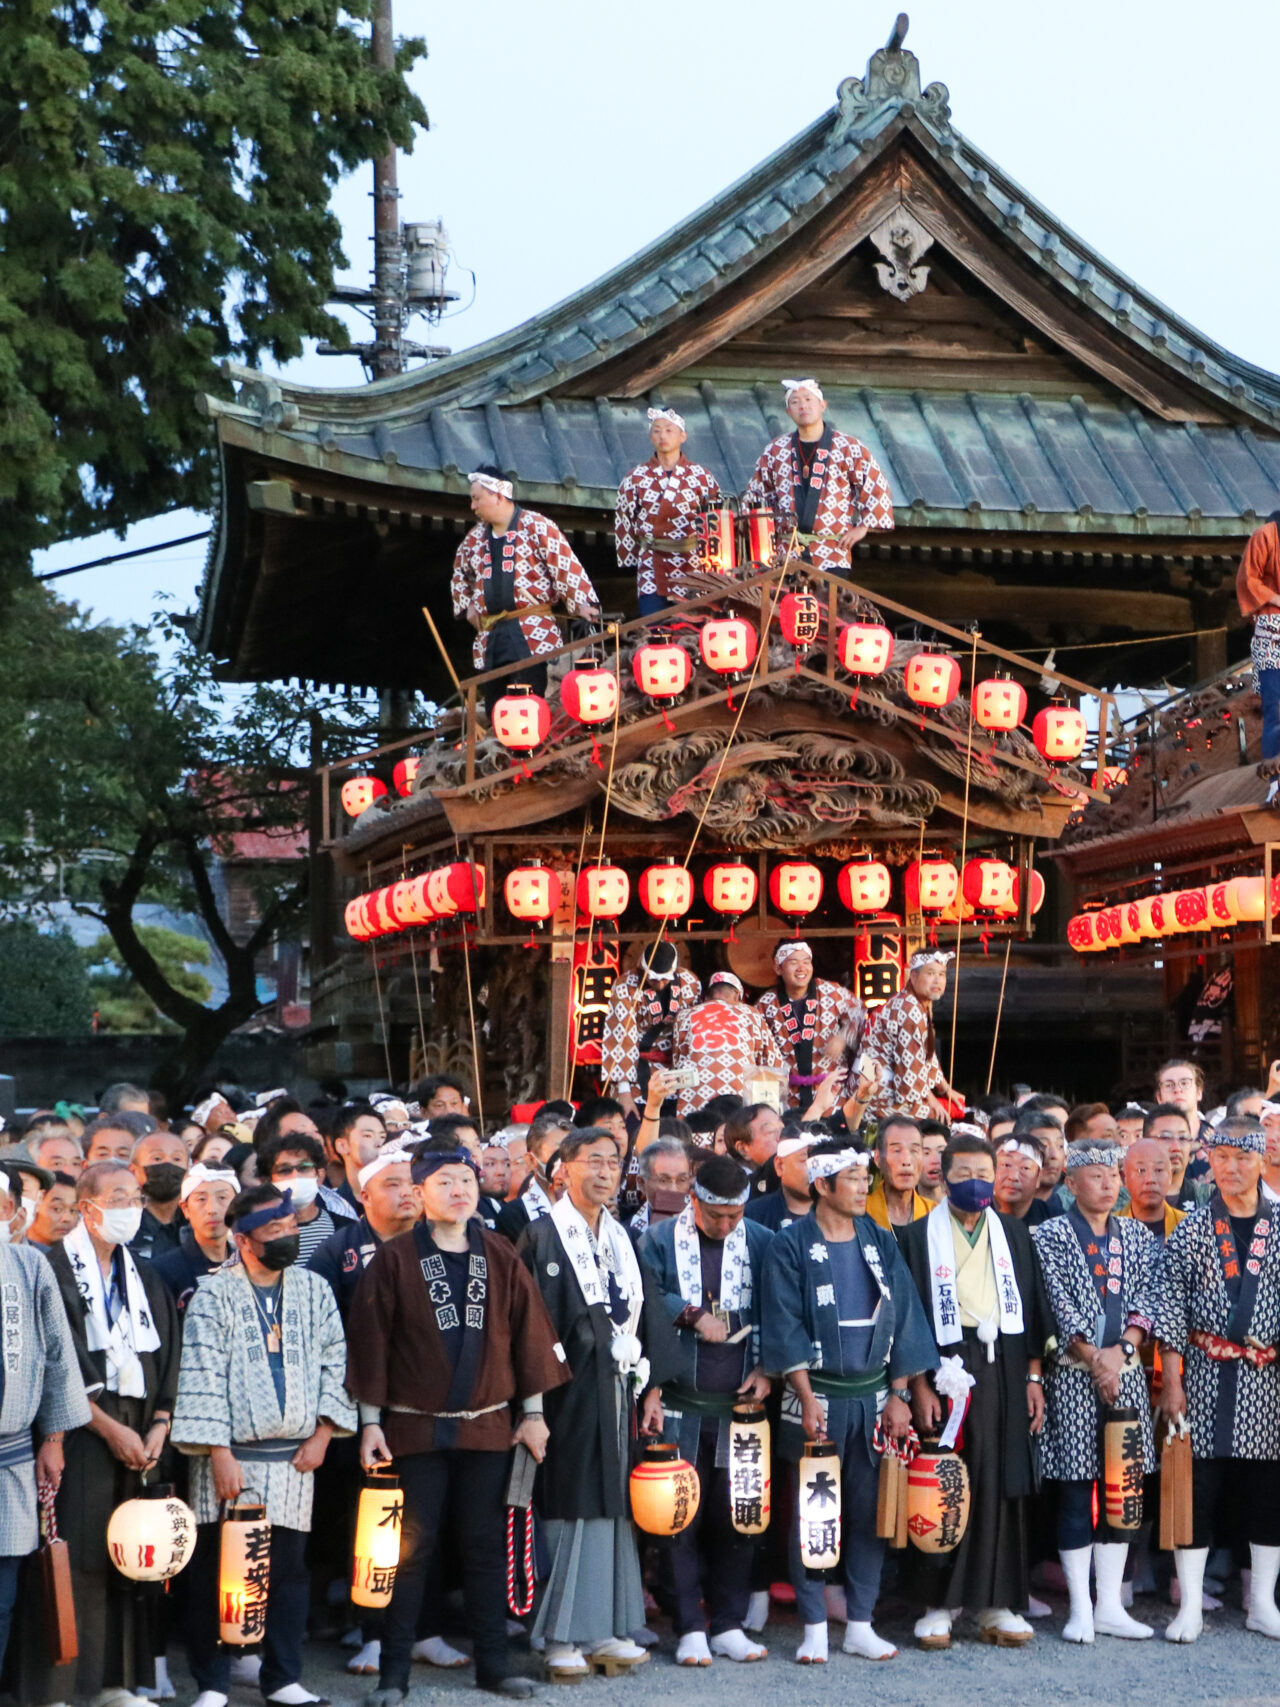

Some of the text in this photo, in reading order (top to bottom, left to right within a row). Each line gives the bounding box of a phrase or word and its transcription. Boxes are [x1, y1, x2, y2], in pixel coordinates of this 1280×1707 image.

[796, 597, 818, 640] 下田町
[937, 1283, 956, 1327] 石橋町
[1001, 1273, 1018, 1316] 石橋町
[733, 1432, 763, 1528] 若衆頭
[806, 1471, 837, 1556] 木頭
[241, 1525, 272, 1638] 若衆頭
[371, 1500, 404, 1595] 木頭
